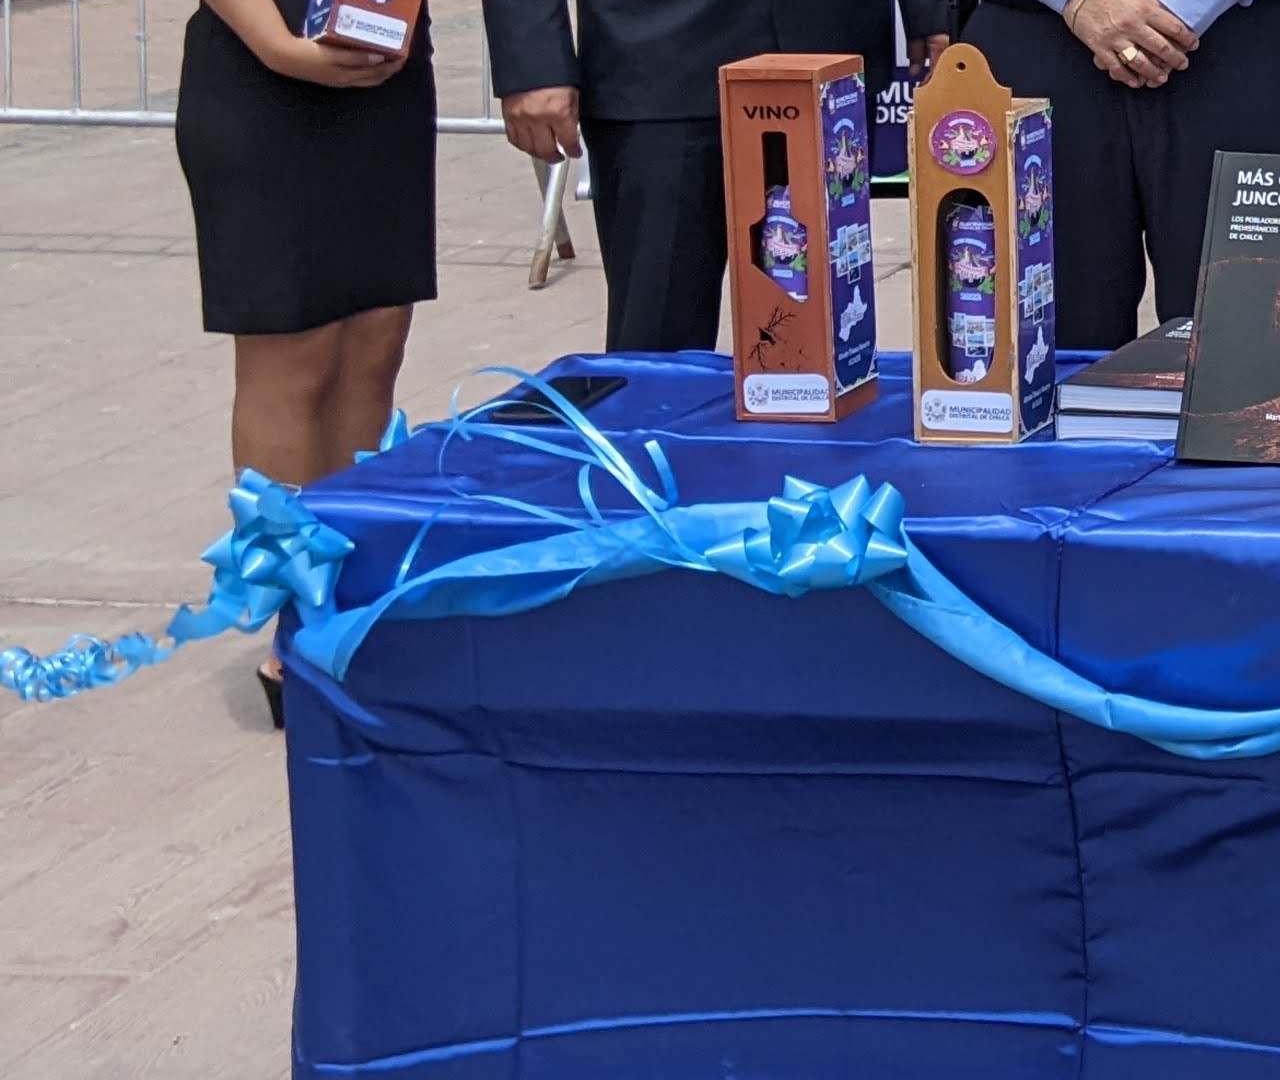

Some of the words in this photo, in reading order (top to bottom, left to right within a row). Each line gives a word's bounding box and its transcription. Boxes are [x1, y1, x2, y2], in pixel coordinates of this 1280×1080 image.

[743, 106, 800, 120] VINO
[1237, 168, 1274, 187] MÁS
[949, 406, 1011, 415] MUNICIPALIDAD
